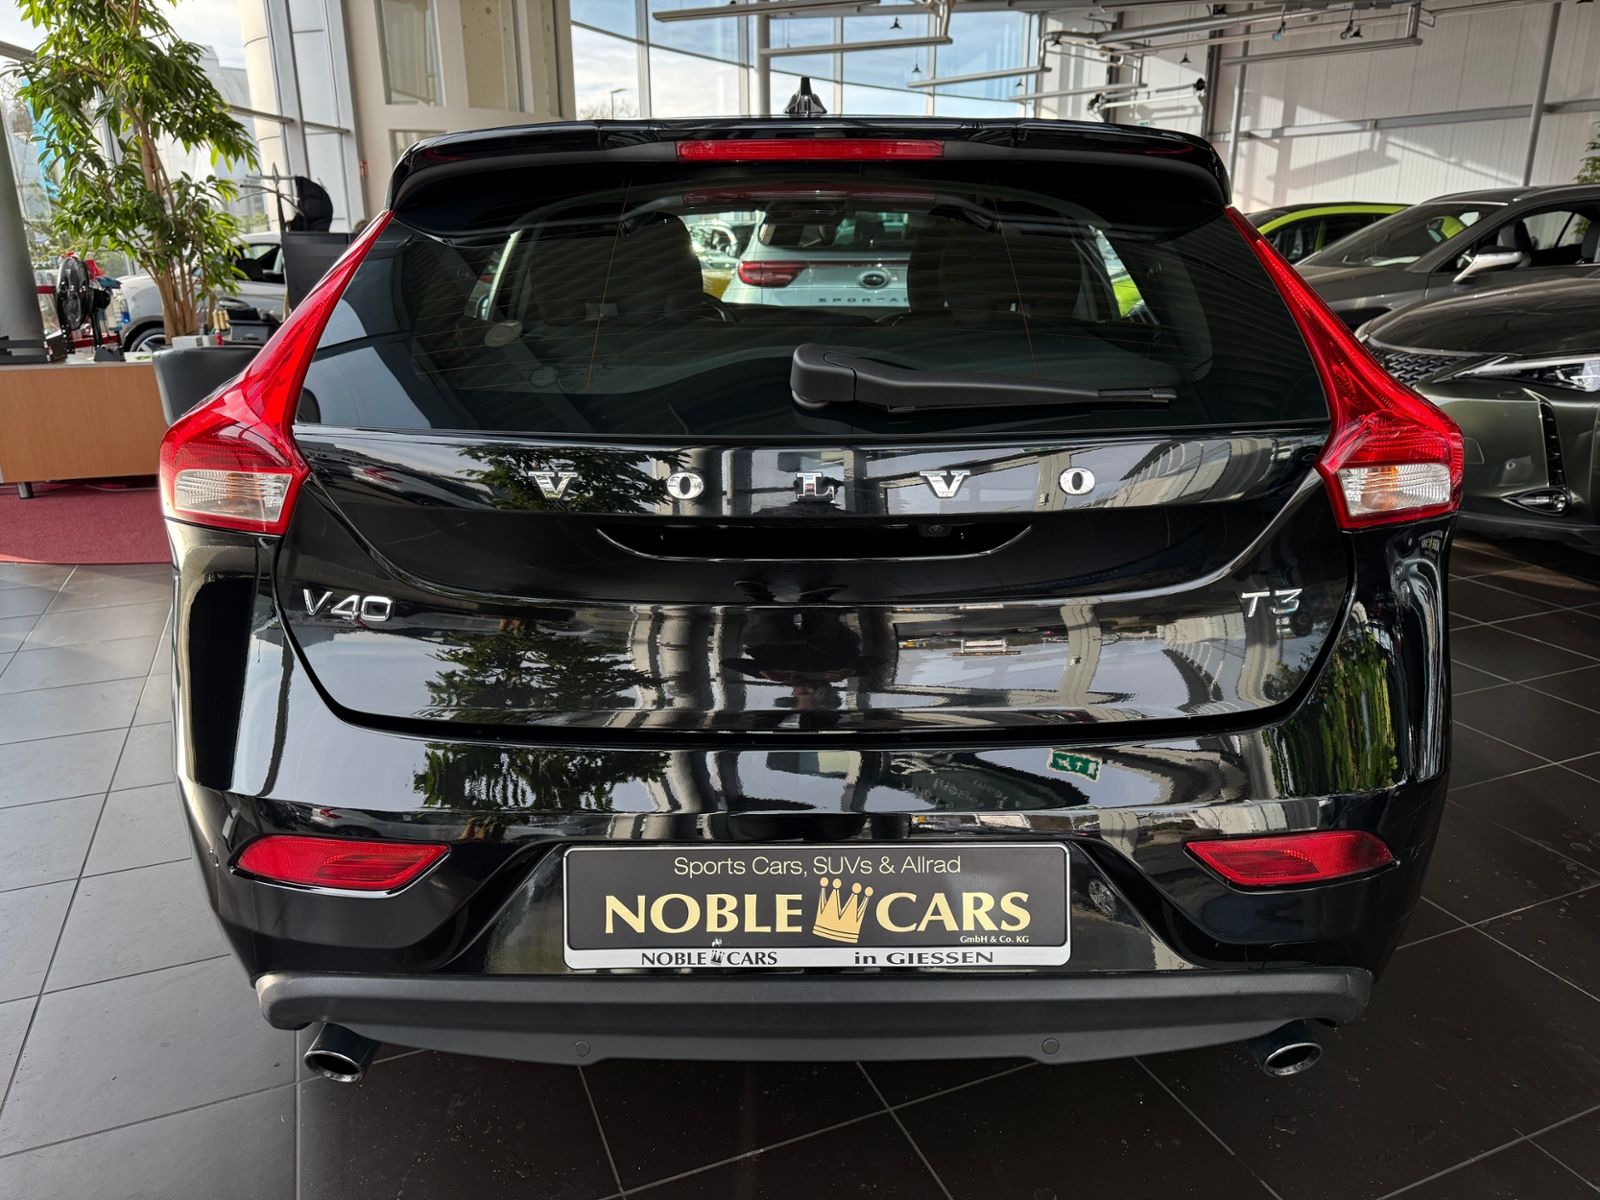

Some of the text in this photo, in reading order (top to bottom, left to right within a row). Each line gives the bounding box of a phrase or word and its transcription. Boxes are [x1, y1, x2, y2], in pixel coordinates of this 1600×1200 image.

[528, 468, 1095, 501] VOLVO
[303, 588, 393, 622] V40
[1241, 588, 1303, 618] T3
[674, 855, 962, 877] Sports Cars, SUVs & Allrad
[604, 891, 1032, 934] NOBLE CARS
[960, 935, 1030, 944] GmbH & Co. KG
[641, 951, 994, 967] NOBLE CARS in GIESSEN
